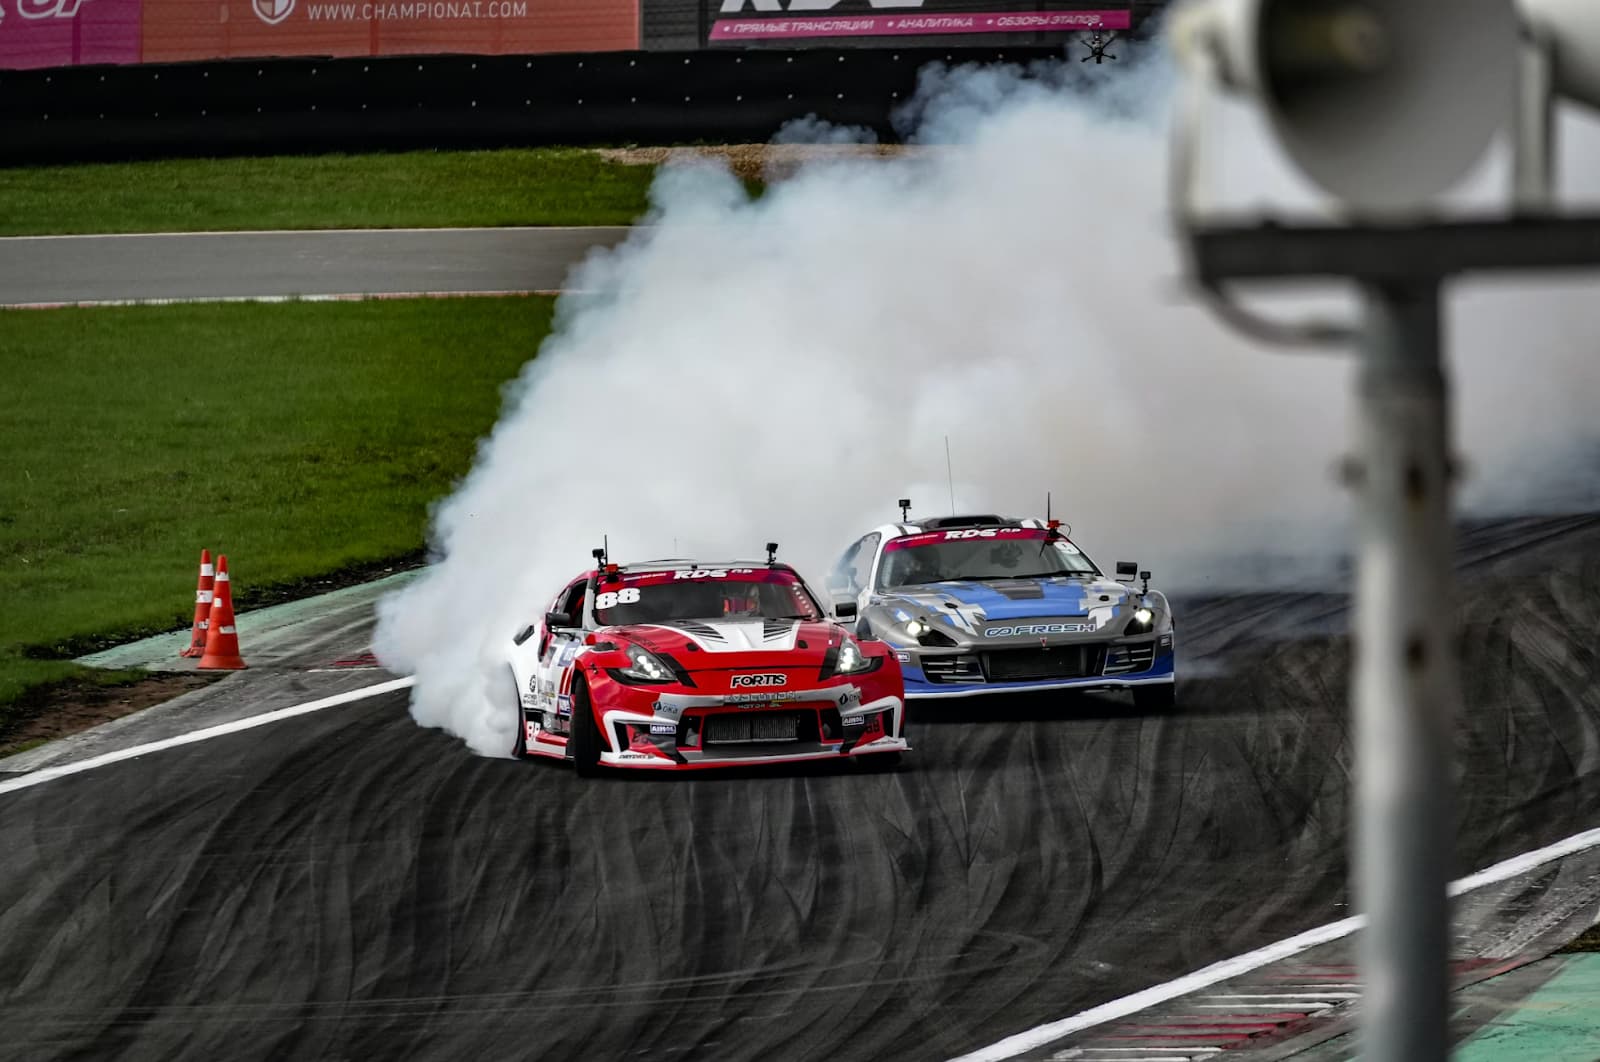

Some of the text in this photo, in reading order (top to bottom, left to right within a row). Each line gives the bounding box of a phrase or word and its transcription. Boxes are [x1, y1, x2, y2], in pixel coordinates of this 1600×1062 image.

[307, 2, 527, 20] WWW.CHAMPIONAT.COM
[733, 14, 1101, 33] ПРЯМЫЕ ТРАНСЛЯЦИИ АНАЛИТИКА ОБЗОРЫ ЭТАПОВ
[595, 587, 641, 610] 88
[730, 673, 787, 689] FORTIS
